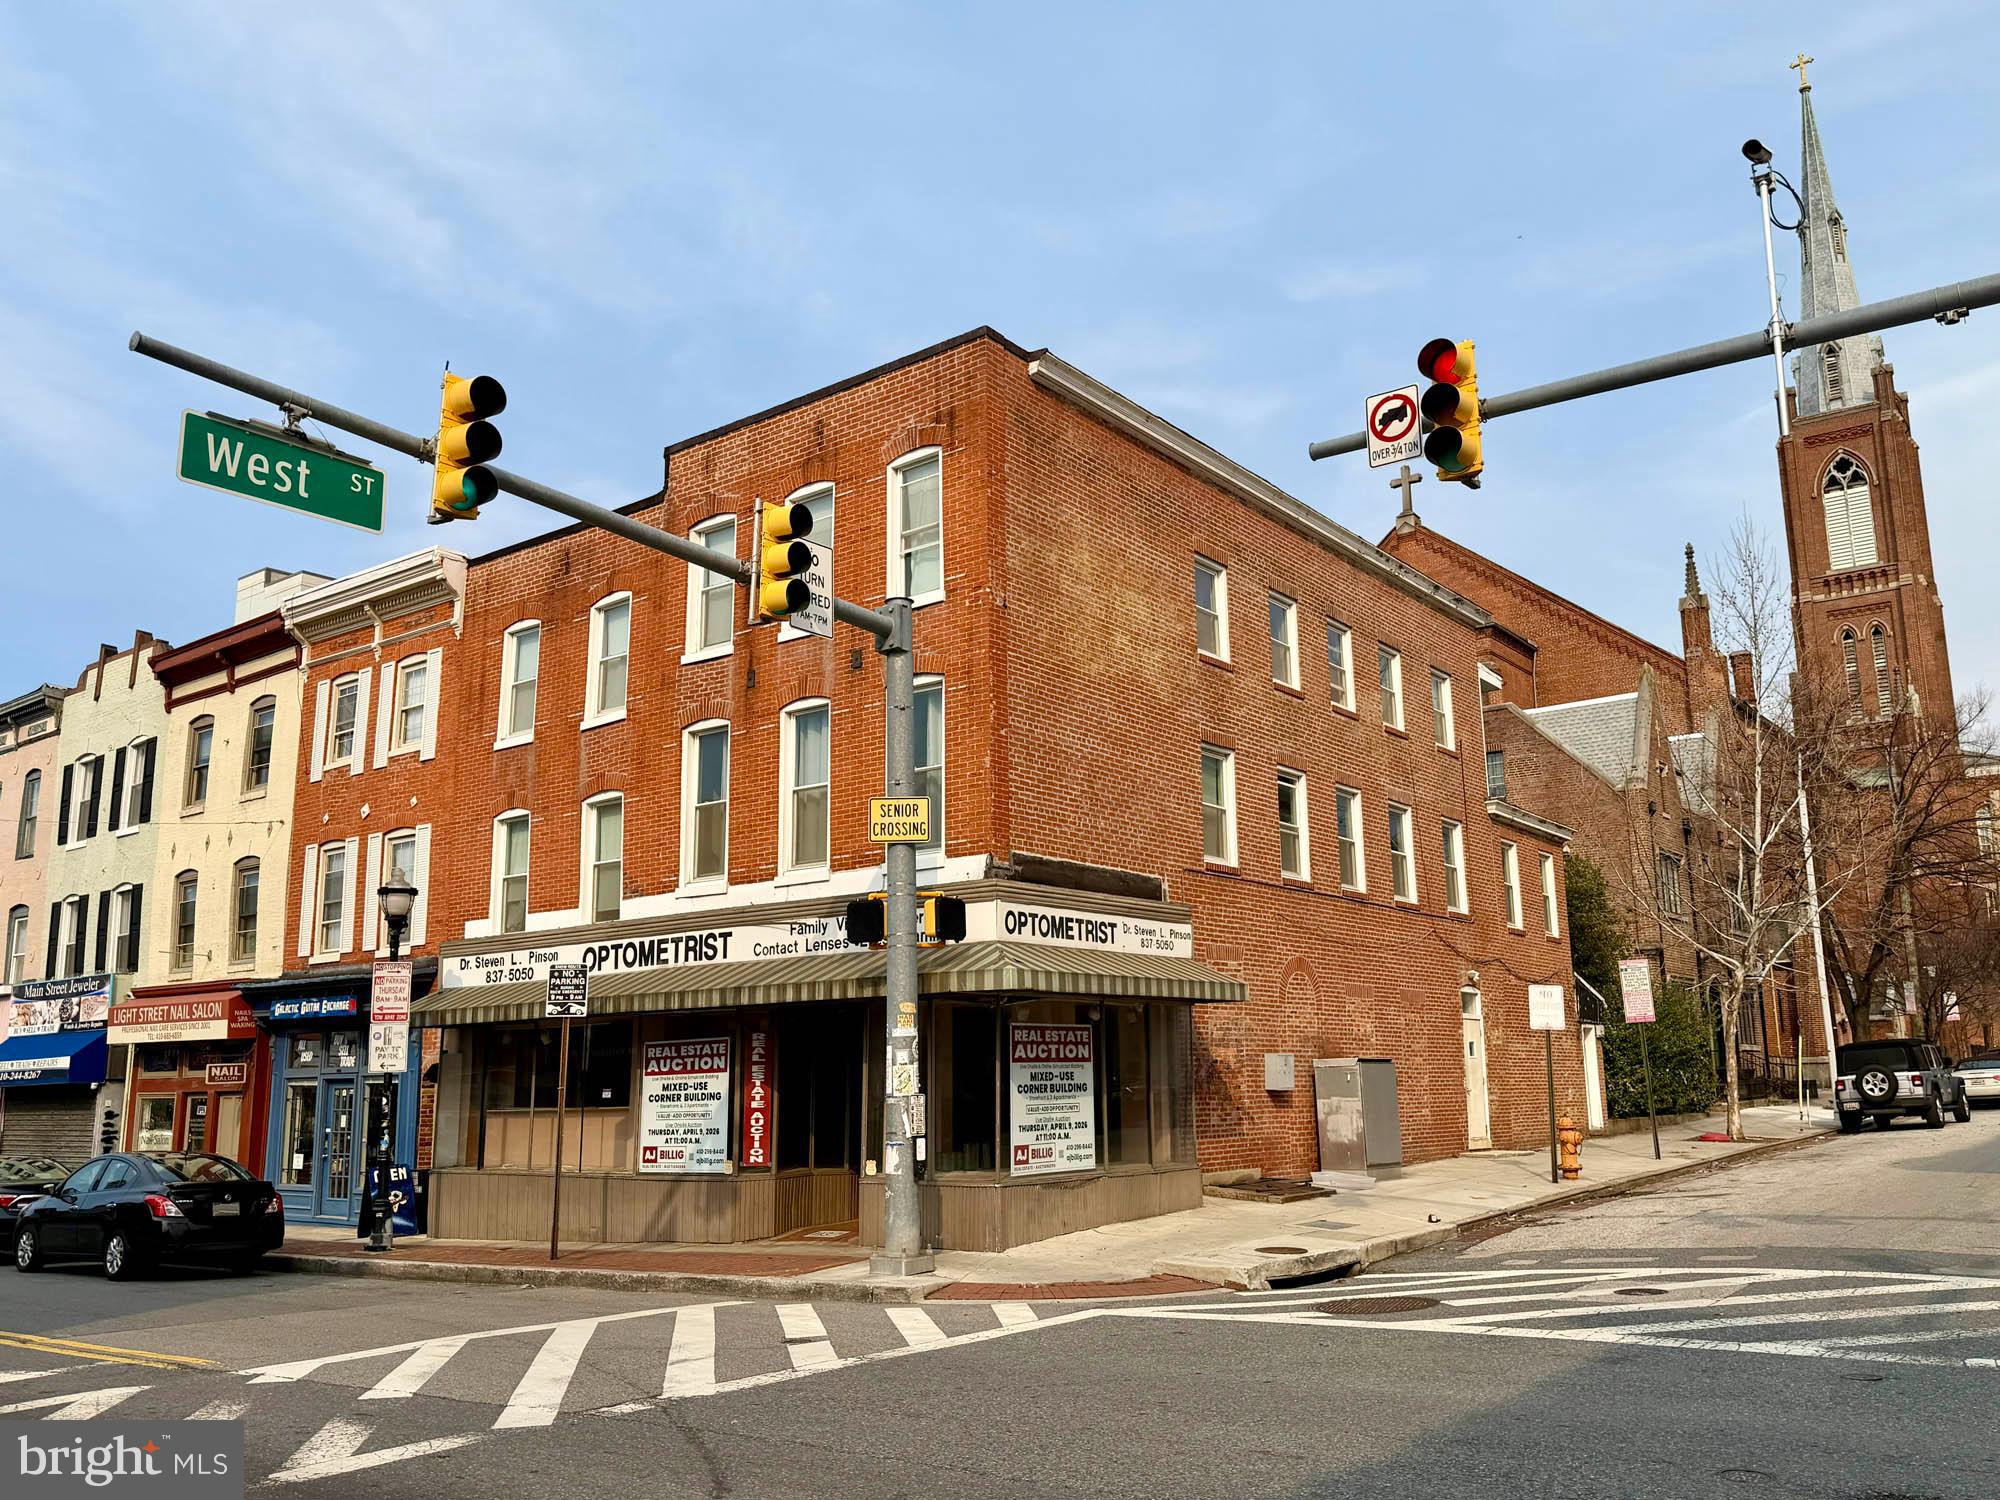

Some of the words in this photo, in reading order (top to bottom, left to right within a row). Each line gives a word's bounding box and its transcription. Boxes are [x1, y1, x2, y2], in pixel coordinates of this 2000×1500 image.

[1372, 447, 1390, 461] OVER
[1390, 442, 1403, 458] 3/4
[1403, 440, 1419, 453] TON
[207, 432, 310, 498] West
[350, 473, 376, 496] ST
[811, 592, 830, 609] RED
[880, 804, 919, 817] SENIOR
[873, 821, 926, 836] CROSSING
[790, 920, 828, 936] Family
[1004, 909, 1117, 945] OPTOMETRIST
[1122, 922, 1132, 936] Dr.
[1134, 924, 1157, 937] Steven
[1159, 927, 1167, 939] L.
[1169, 928, 1191, 941] Pinson
[582, 931, 733, 973] OPTOMETRIST
[753, 940, 799, 957] Contact
[805, 938, 849, 953] Lenses
[459, 956, 473, 970] Dr.
[475, 954, 508, 969] Steven
[511, 952, 522, 966] L.
[528, 950, 559, 964] Pinson
[376, 977, 384, 985] NO
[386, 977, 408, 985] PARKING
[485, 967, 534, 984] 837-5050
[24, 984, 44, 998] Main
[45, 982, 68, 996] Street
[69, 978, 100, 994] Jeweler
[379, 986, 406, 994] THURSDAY
[113, 1008, 138, 1024] LIGHT
[138, 1006, 169, 1022] STREET
[170, 1004, 191, 1020] NAIL
[192, 1001, 222, 1019] SALON
[1014, 1030, 1043, 1042] REAL
[1045, 1030, 1089, 1042] ESTATE
[647, 1046, 678, 1058] REAL
[680, 1043, 726, 1056] ESTATE
[751, 1033, 766, 1062] REAL
[1014, 1044, 1089, 1059] AUCTION
[211, 1067, 241, 1076] NAIL
[647, 1056, 725, 1073] AUCTION
[1030, 1072, 1074, 1082] MIXED-USE
[662, 1082, 708, 1092] MIXED-USE
[750, 1064, 766, 1109] ESTATE
[1017, 1084, 1048, 1094] CORNER
[1050, 1083, 1087, 1093] BUILDING
[648, 1093, 682, 1103] CORNER
[684, 1092, 722, 1102] BUILDING
[648, 1128, 681, 1136] THURSDAY,
[1018, 1123, 1050, 1132] THURSDAY,
[1050, 1123, 1067, 1131] APRIL
[1074, 1121, 1088, 1129] 2026
[749, 1111, 765, 1163] AUCTION
[1057, 1132, 1072, 1140] A.M.
[644, 1149, 657, 1160] AJ
[659, 1150, 684, 1160] BILLIG
[1016, 1149, 1028, 1162] AJ
[1031, 1147, 1053, 1159] BILLIG
